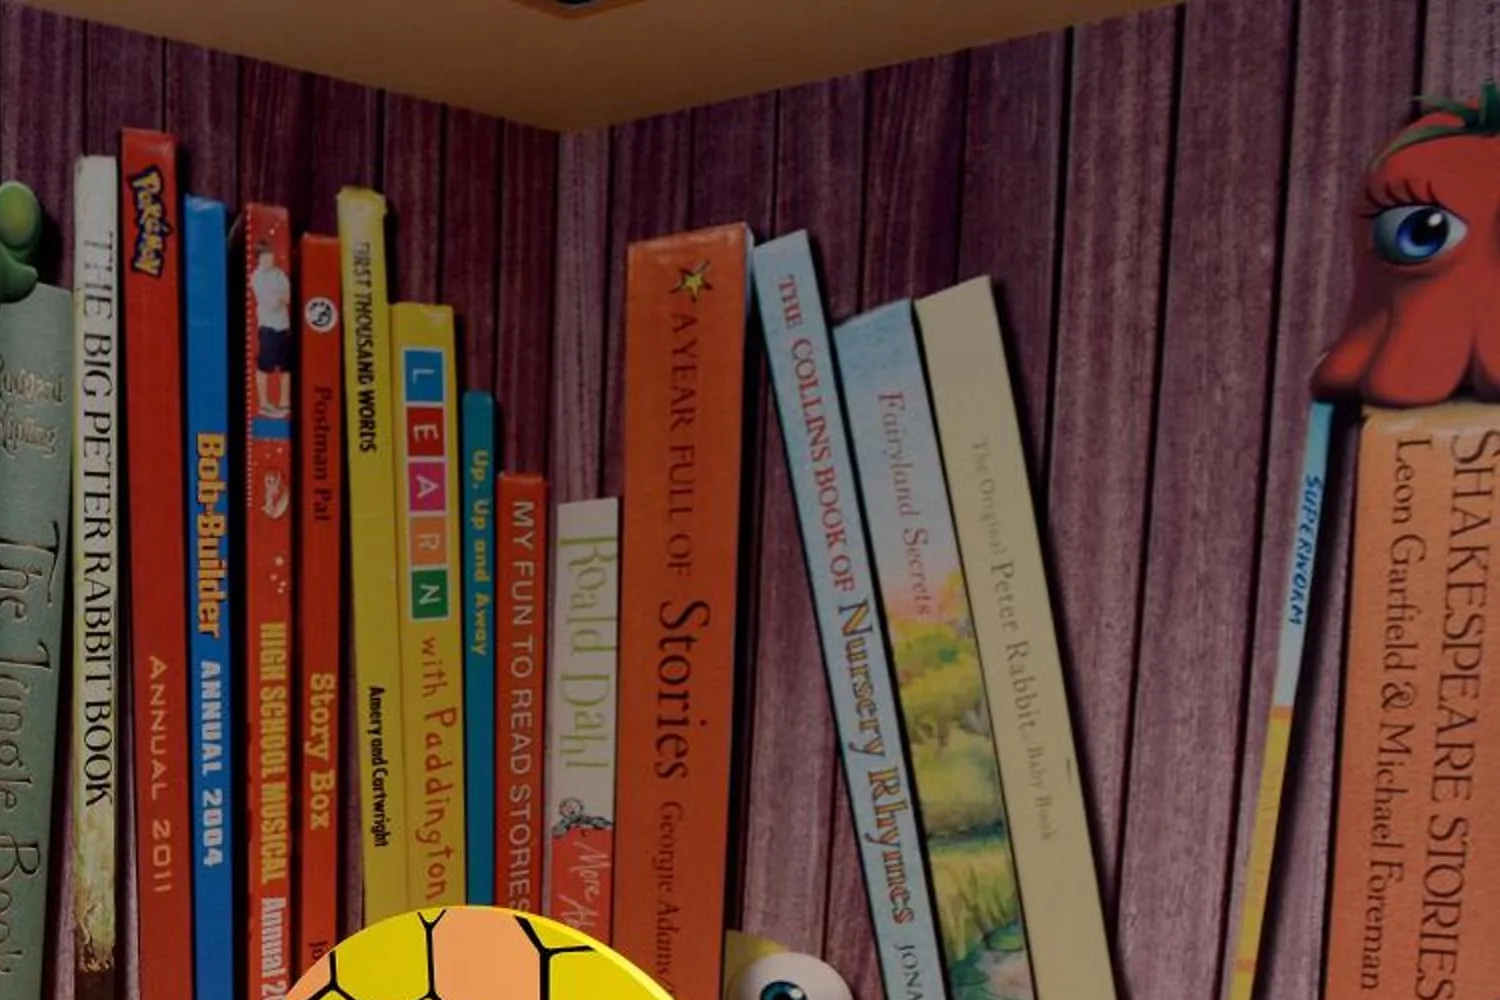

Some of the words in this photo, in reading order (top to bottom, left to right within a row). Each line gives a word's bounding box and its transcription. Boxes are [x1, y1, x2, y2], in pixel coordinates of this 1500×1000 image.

[83, 231, 113, 320] THE
[779, 275, 804, 328] THE
[83, 334, 112, 398] BIG
[355, 292, 375, 385] THOUSAND
[671, 312, 698, 335] A
[360, 387, 377, 454] WORDS
[669, 340, 698, 433] YEAR
[791, 338, 832, 463] COLLINS
[84, 411, 112, 540] PETER
[411, 366, 442, 607] LEARN
[472, 500, 489, 530] Up
[668, 443, 696, 518] FULL
[815, 466, 848, 548] BOOK
[1391, 437, 1433, 525] Leon
[474, 539, 490, 583] and
[512, 500, 535, 549] MY
[667, 534, 693, 578] OF
[1288, 473, 1323, 626] SUPERWORM
[511, 561, 534, 626] FUN
[558, 536, 618, 656] Roald
[831, 554, 856, 592] OF
[902, 526, 933, 617] Secrets
[990, 559, 1018, 633] Peter
[1383, 534, 1428, 671] Garfield
[1431, 428, 1500, 803] SHAKESPEARE
[84, 551, 112, 692] RABBIT
[260, 622, 287, 681] HIGH
[469, 592, 490, 656] Away
[511, 635, 533, 678] TO
[421, 635, 448, 698] with
[655, 600, 711, 779] Stories
[1006, 640, 1041, 731] Rabbit
[1380, 681, 1417, 710] &
[84, 701, 113, 807] BOOK
[150, 656, 168, 800] ANNUAL
[201, 660, 223, 776] ANNUAL
[260, 686, 288, 778] SCHOOL
[304, 673, 336, 761] Story
[511, 689, 533, 775] READ
[559, 673, 612, 769] Dahl
[310, 769, 336, 831] Box
[416, 707, 457, 901] Paddington
[838, 600, 886, 757] Nursery
[864, 766, 916, 925] Rhymes
[1371, 721, 1415, 849] Michael
[153, 819, 172, 893] 2011
[203, 788, 224, 868] 2004
[260, 781, 289, 884] MUSICAL
[508, 783, 532, 915] STORIES
[569, 839, 613, 900] More
[261, 896, 287, 978] Annual
[1360, 860, 1405, 991] Foreman
